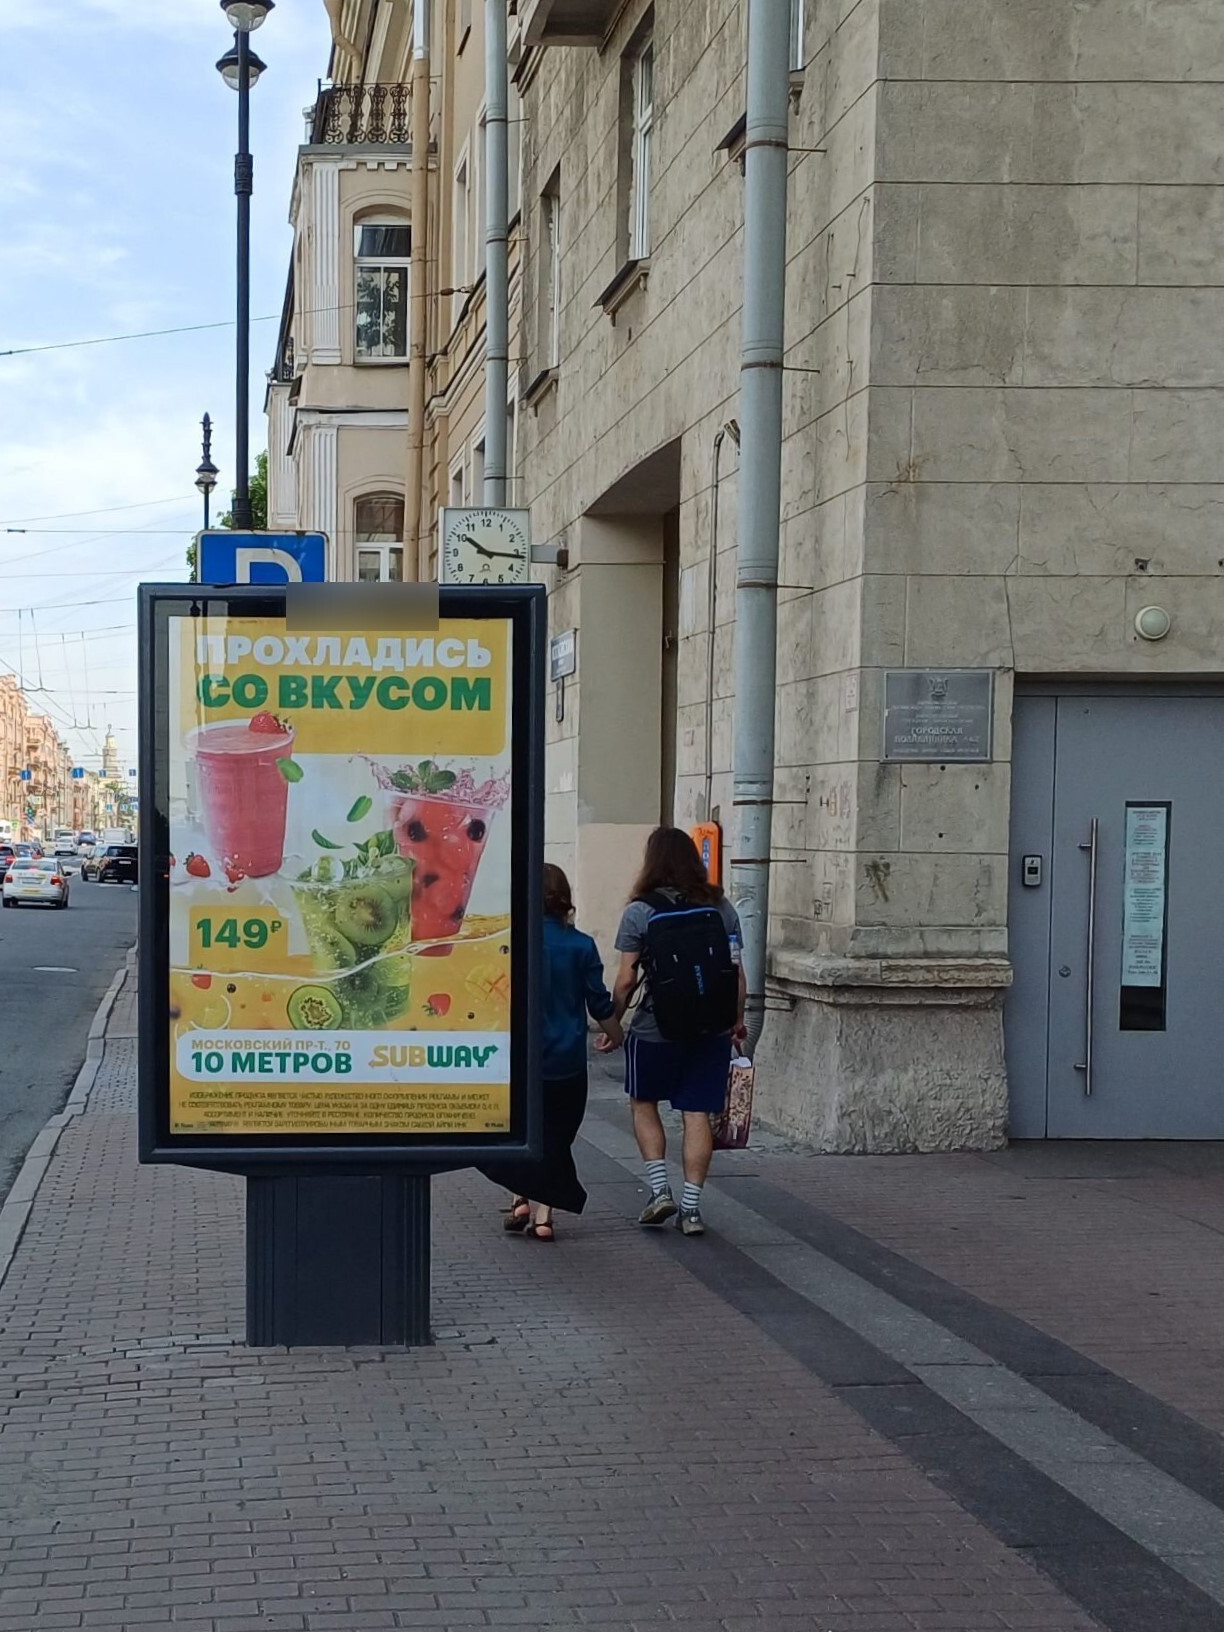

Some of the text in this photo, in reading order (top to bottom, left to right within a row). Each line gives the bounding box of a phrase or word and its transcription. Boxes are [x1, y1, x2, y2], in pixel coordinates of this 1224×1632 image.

[465, 523, 475, 532] 11
[481, 518, 492, 528] 12
[499, 523, 503, 533] 1
[456, 533, 468, 543] 10
[509, 533, 515, 543] 2
[507, 563, 514, 573] 4
[468, 574, 475, 583] 7
[498, 574, 504, 584] 5
[196, 634, 492, 672] ПРОХЛАДИСЬ
[196, 673, 492, 712] СО ВКУСОМ
[191, 1038, 292, 1051] МОСКОВСКИЙ
[334, 1040, 351, 1051] 70
[368, 1044, 499, 1068] SUBWAY
[191, 1051, 352, 1074] 10 МЕТРОВ
